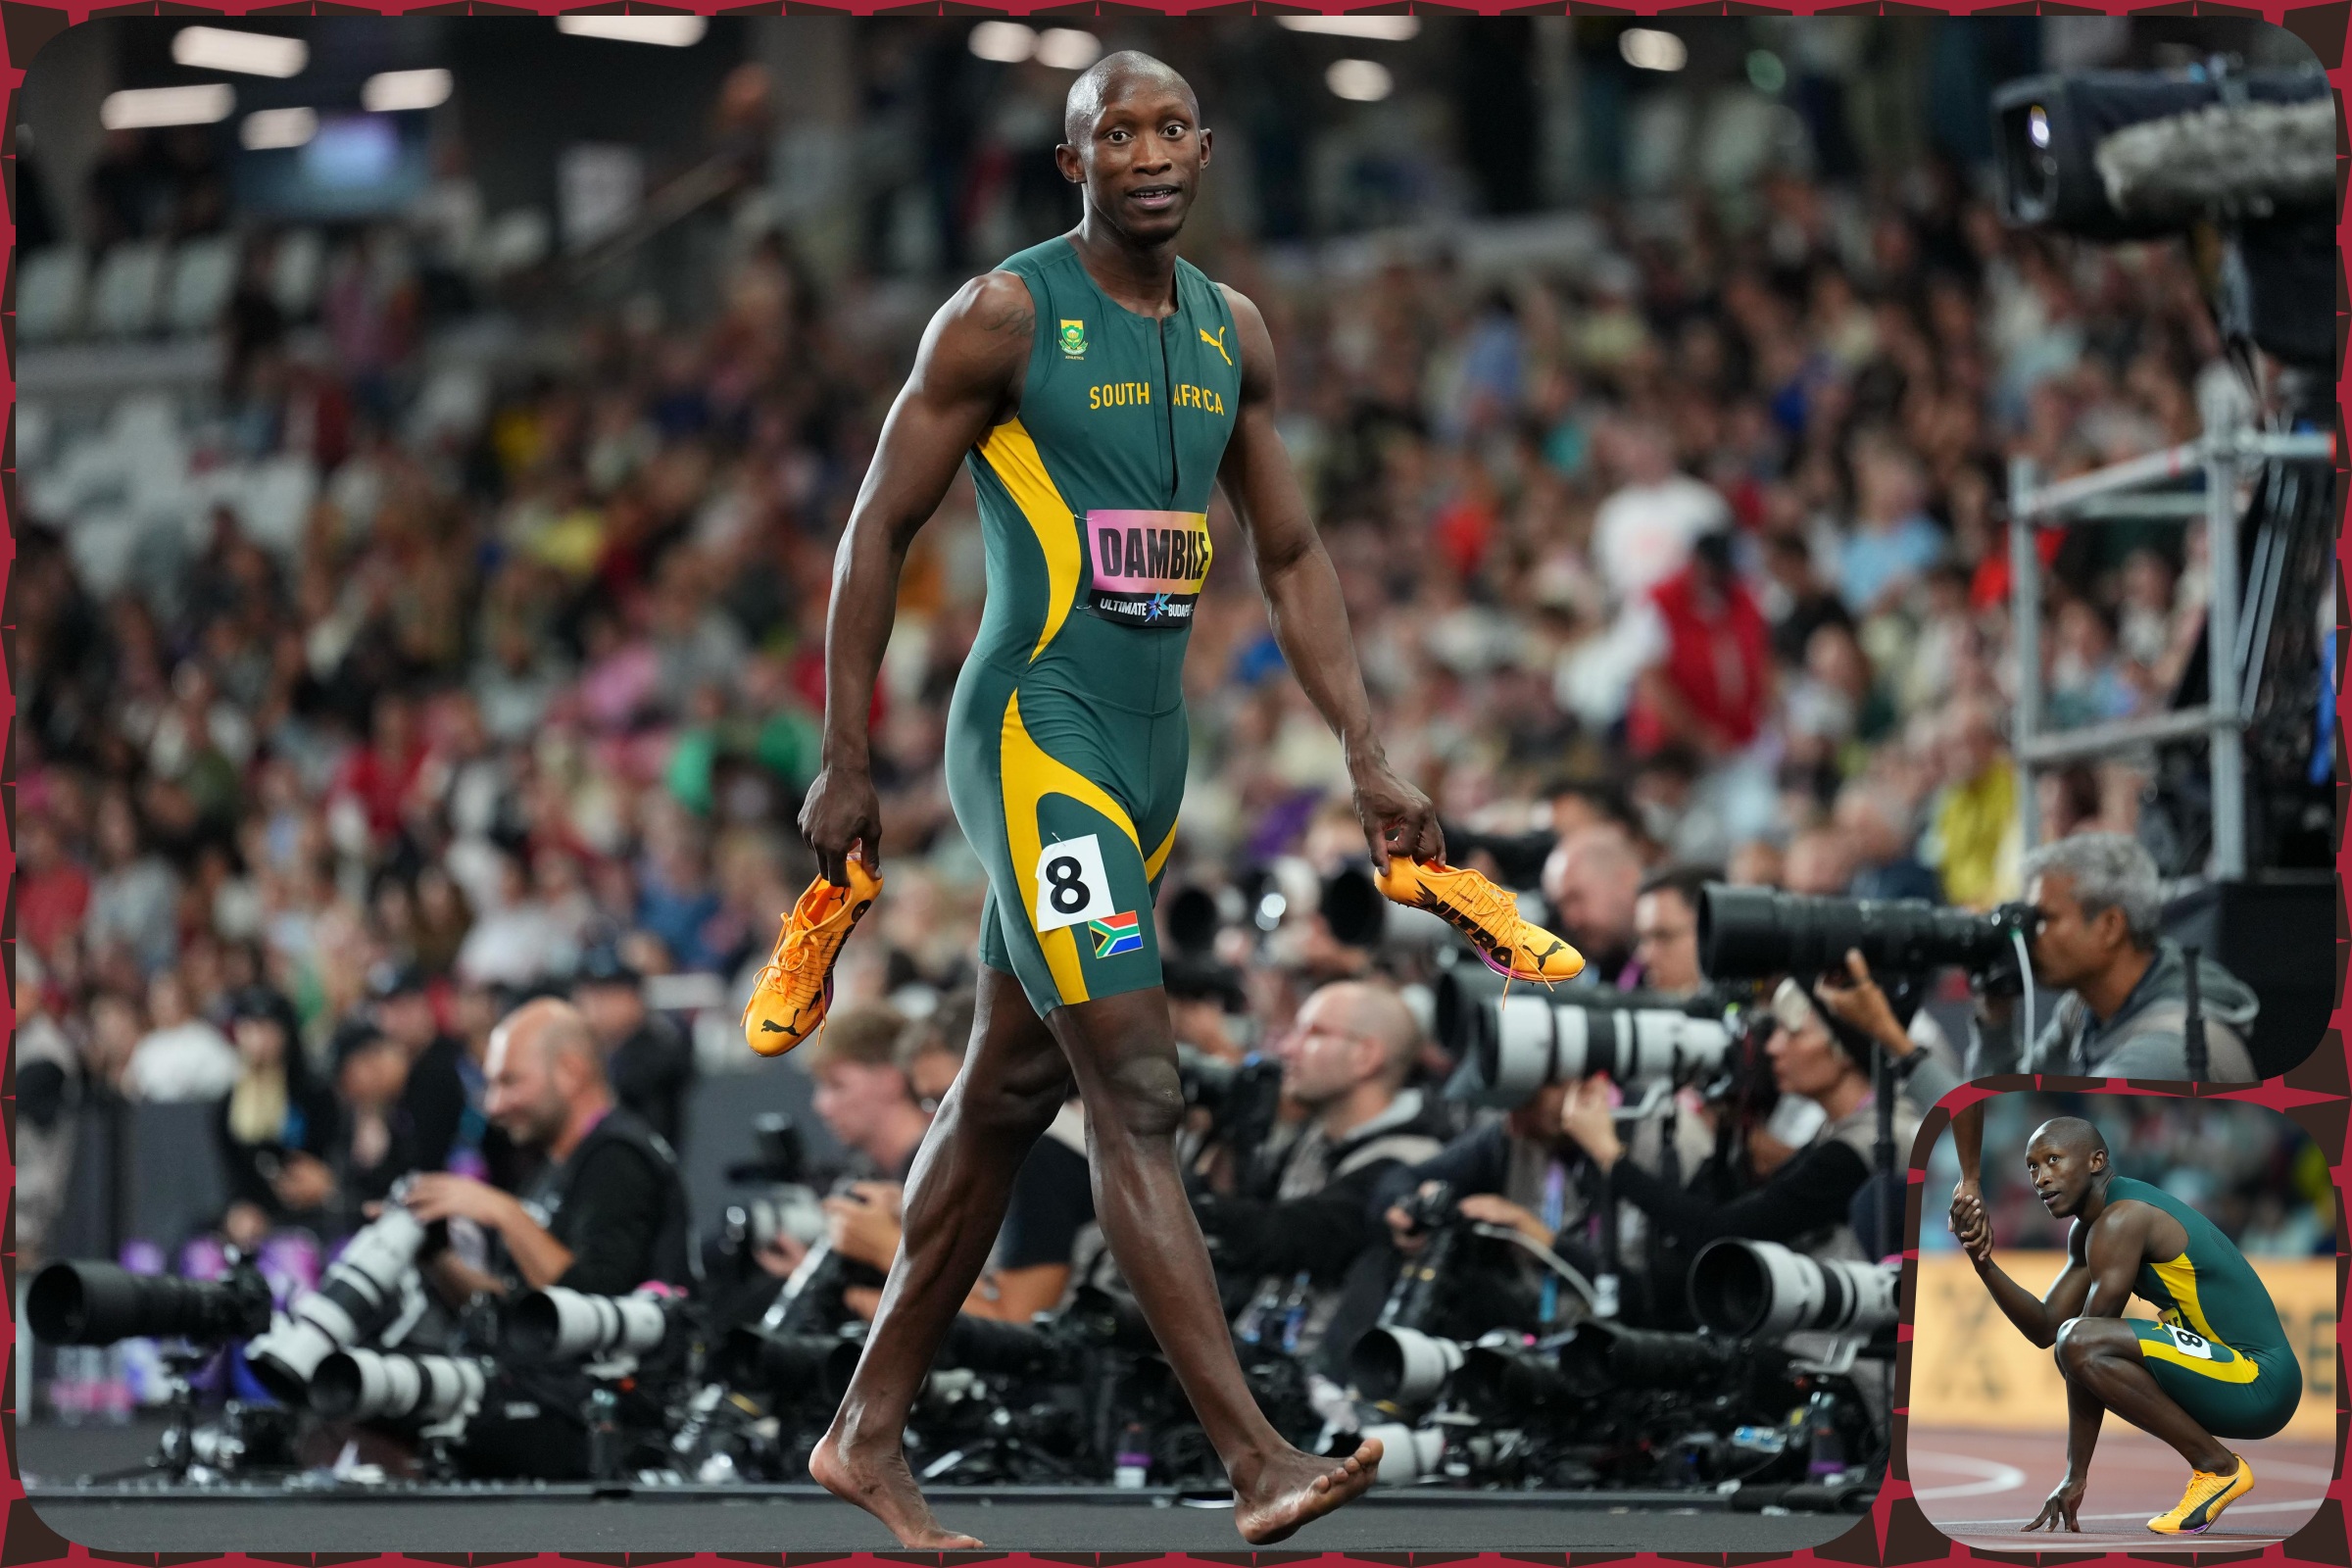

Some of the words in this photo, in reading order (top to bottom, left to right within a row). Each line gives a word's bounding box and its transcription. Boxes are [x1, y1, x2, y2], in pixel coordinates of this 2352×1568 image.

[1090, 382, 1150, 410] SOUTH
[1173, 383, 1224, 416] AFRCA
[1099, 527, 1208, 580] DAMBILE
[1100, 598, 1147, 615] ULTIMATE
[1046, 856, 1091, 913] 8
[2177, 1331, 2203, 1348] 8
